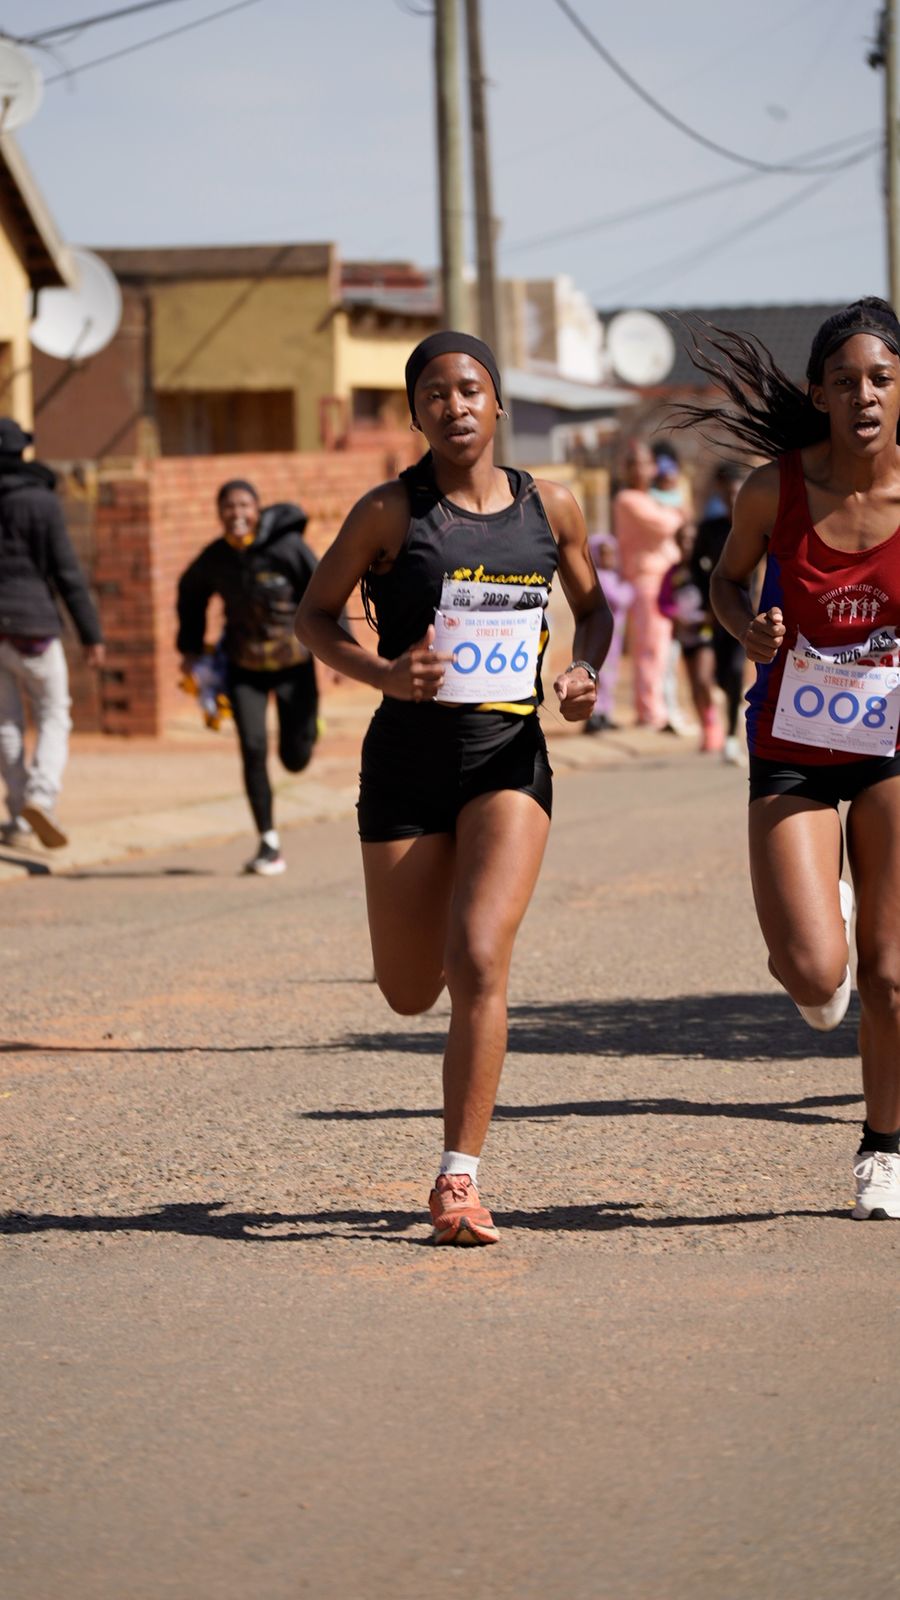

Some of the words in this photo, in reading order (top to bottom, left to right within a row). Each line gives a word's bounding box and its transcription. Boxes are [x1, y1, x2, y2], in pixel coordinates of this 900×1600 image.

[481, 591, 510, 607] 2026
[844, 583, 873, 593] ATHLETIC
[872, 588, 890, 604] CLUB
[475, 628, 498, 637] STREET
[500, 627, 514, 636] MILE
[452, 641, 529, 674] 066
[833, 648, 861, 665] 2026
[823, 675, 848, 688] STREET
[849, 678, 865, 690] MILE
[794, 685, 887, 728] 008
